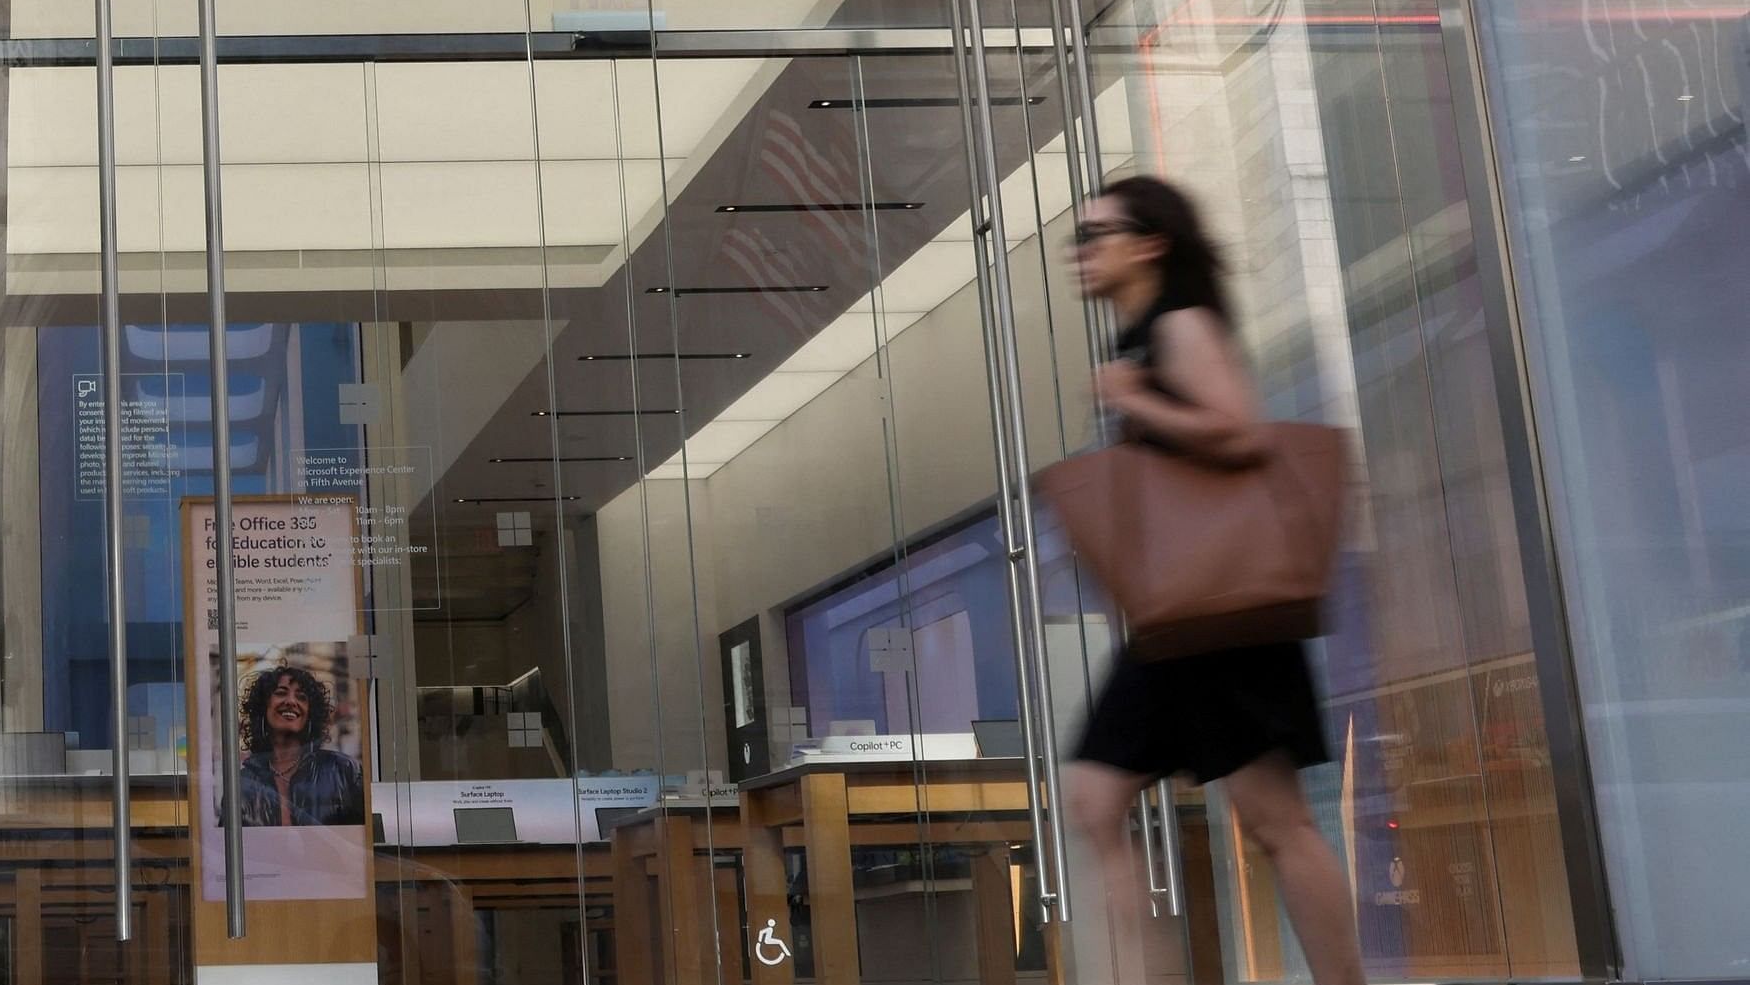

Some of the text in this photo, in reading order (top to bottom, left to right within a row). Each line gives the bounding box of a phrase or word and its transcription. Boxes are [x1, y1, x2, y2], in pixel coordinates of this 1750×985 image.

[297, 456, 336, 465] Welcome
[298, 466, 416, 476] Microsoft Experience Center
[311, 478, 331, 487] Fifth
[332, 478, 364, 487] Avenue
[298, 496, 313, 505] We
[330, 496, 355, 506] open:
[355, 505, 378, 514] 10am
[385, 505, 405, 515] 8pm
[239, 517, 286, 530] Office
[356, 517, 377, 526] 11am
[384, 517, 404, 527] 6pm
[233, 535, 306, 549] Education
[350, 534, 396, 543] to book an
[378, 546, 393, 554] our
[394, 544, 428, 553] in-store
[484, 791, 505, 799] Laptop
[600, 787, 622, 796] Laptop
